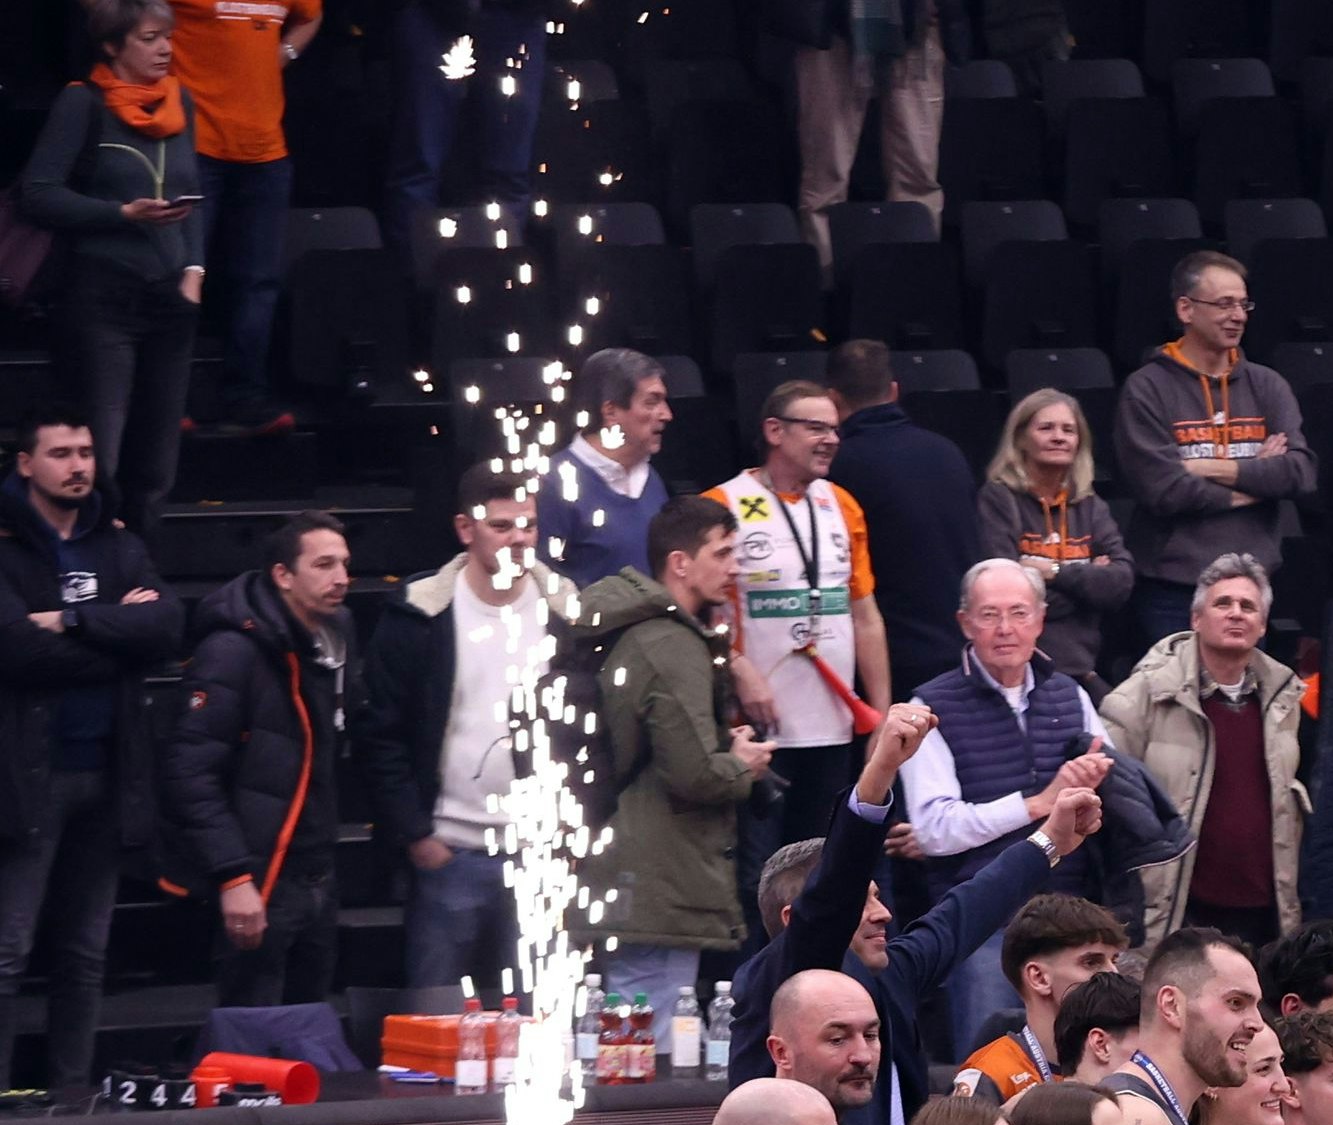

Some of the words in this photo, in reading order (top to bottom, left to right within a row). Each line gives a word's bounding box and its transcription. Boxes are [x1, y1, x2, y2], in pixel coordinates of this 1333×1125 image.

[119, 1080, 138, 1104] 2
[151, 1083, 168, 1107] 4
[180, 1083, 197, 1107] 4
